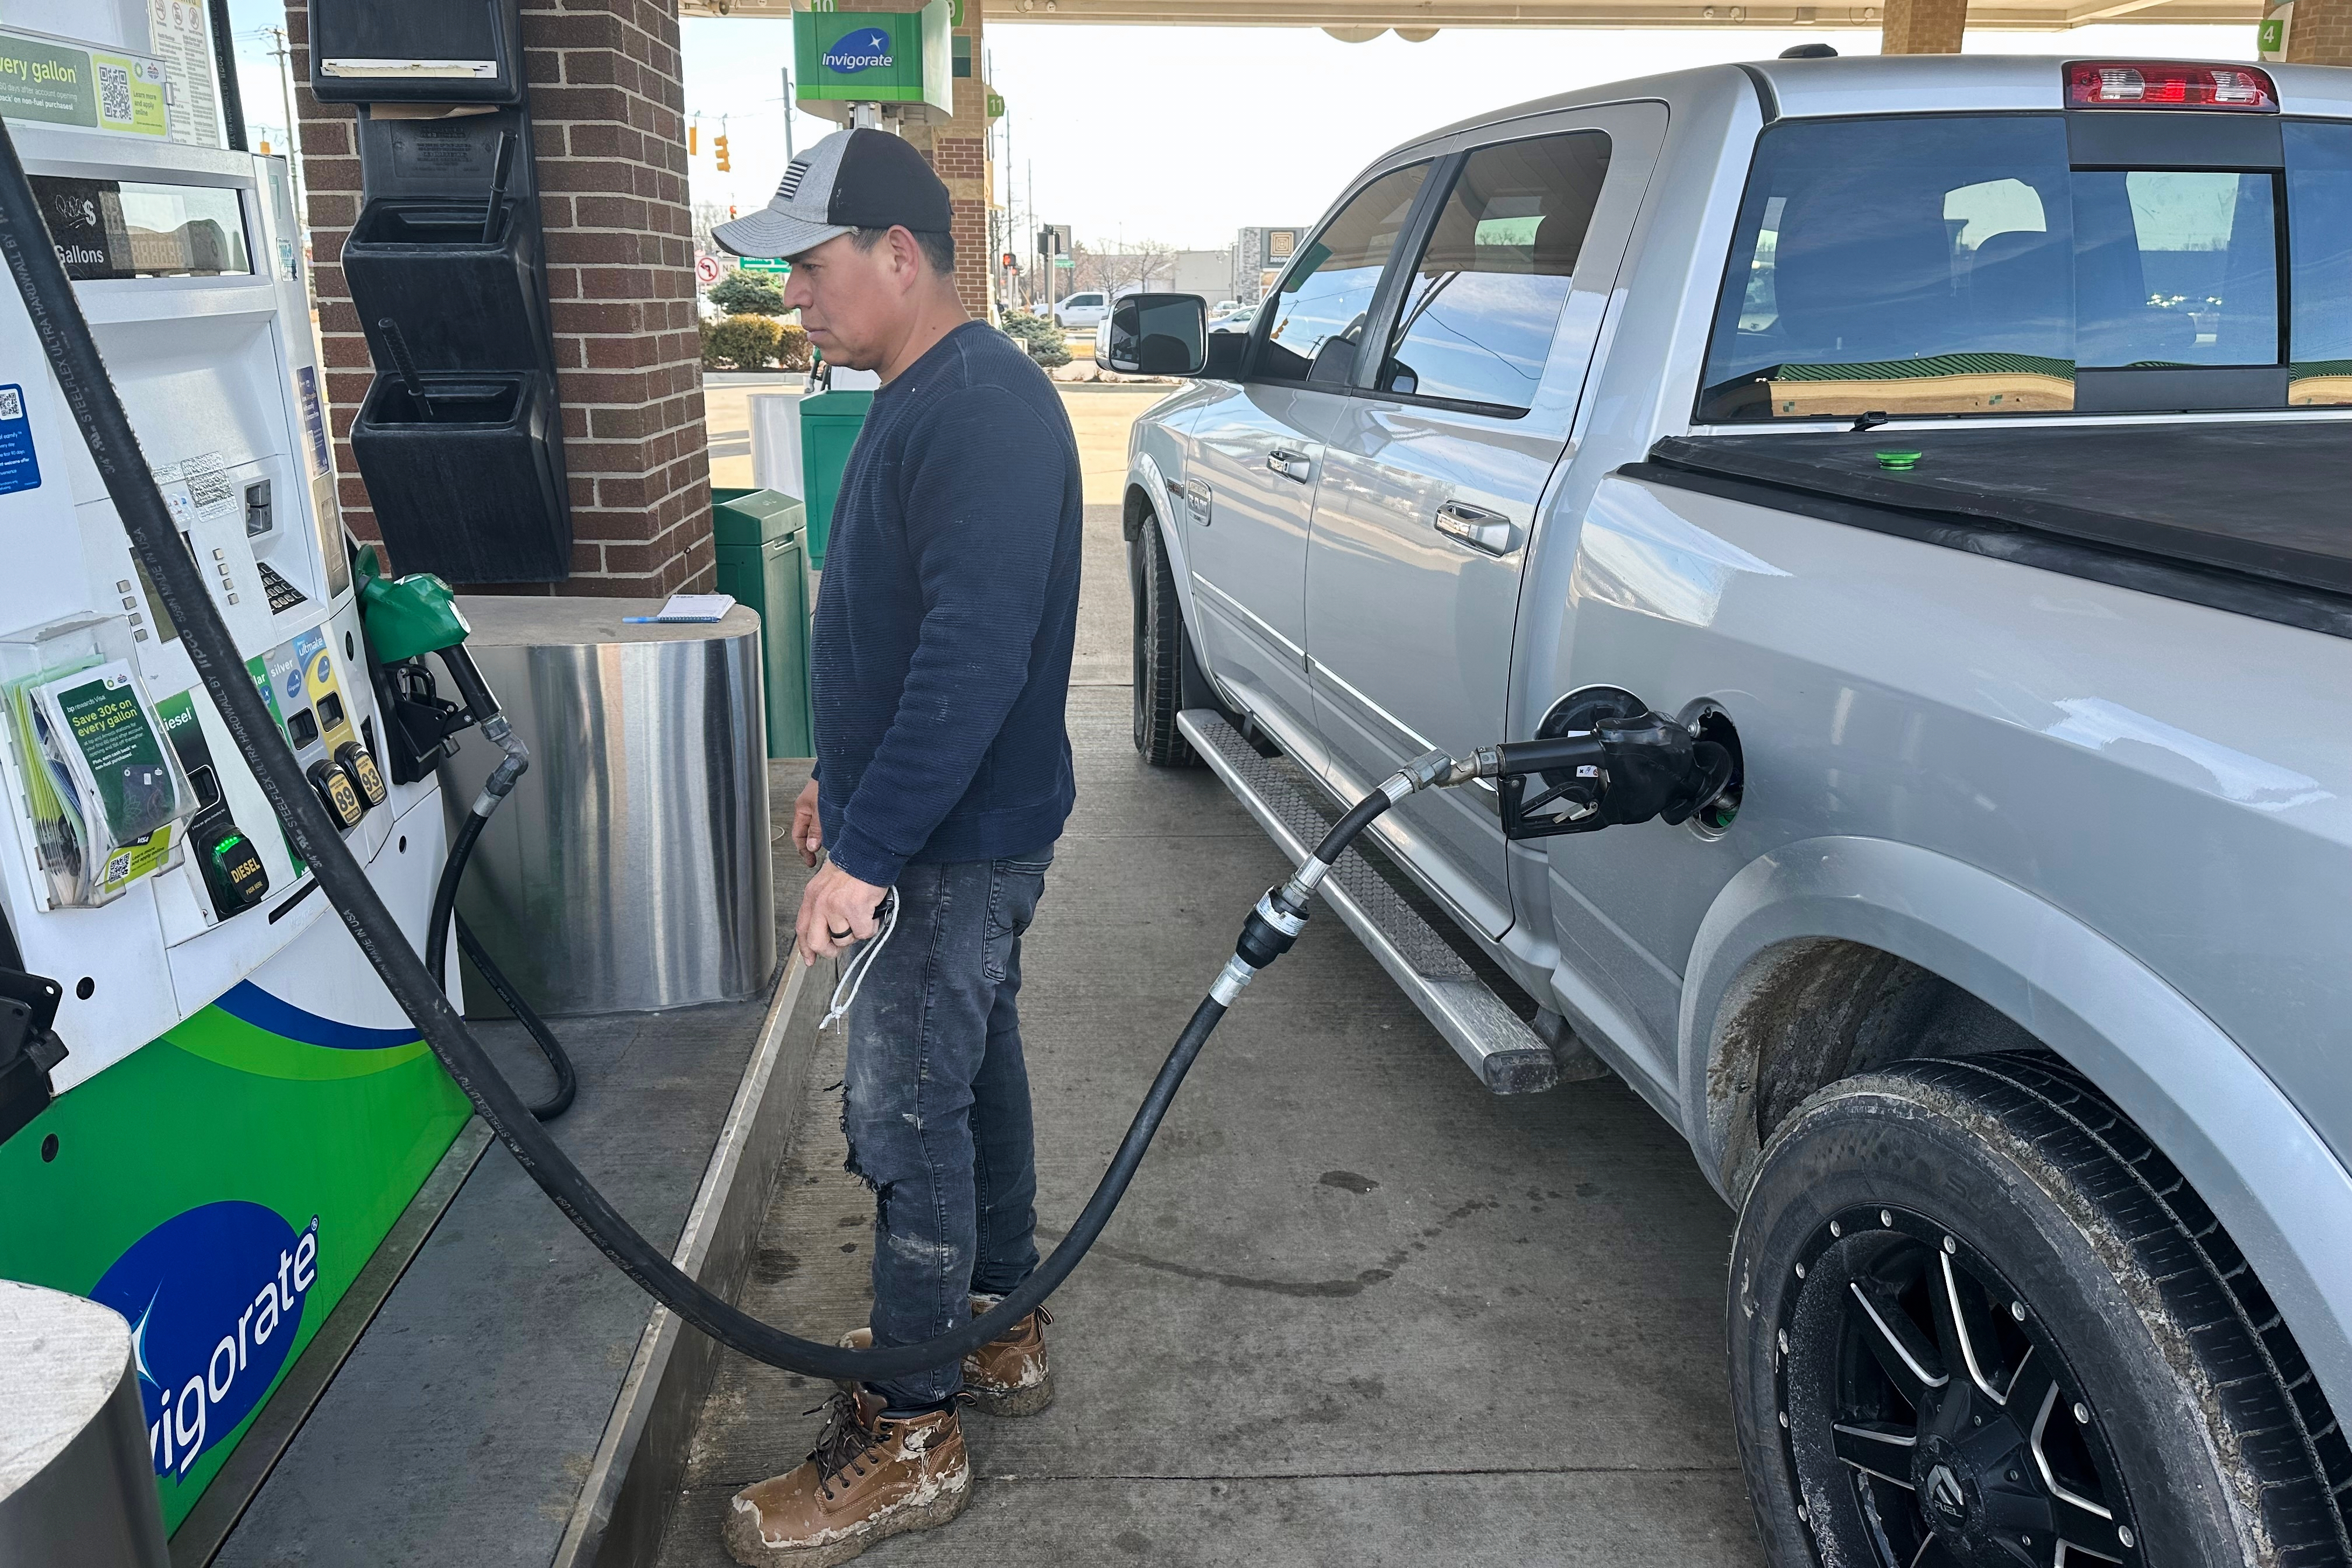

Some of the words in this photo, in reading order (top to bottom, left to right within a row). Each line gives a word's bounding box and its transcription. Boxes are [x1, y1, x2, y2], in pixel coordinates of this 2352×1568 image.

[2263, 26, 2274, 43] 4
[822, 53, 892, 69] Invigorate
[7, 84, 20, 94] days
[34, 88, 55, 97] account
[57, 92, 77, 102] opening
[133, 90, 145, 99] Learn
[142, 102, 154, 110] apply
[990, 99, 1003, 112] 11
[83, 200, 96, 227] $
[1, 232, 18, 248] BY
[55, 244, 104, 264] Gallons
[9, 253, 46, 315] HARDWALL
[38, 318, 63, 355] ULTRA
[57, 359, 93, 422] STEELFLEX
[1188, 494, 1207, 514] RAM
[132, 527, 150, 549] USA
[144, 551, 157, 564] IN
[150, 565, 173, 596] MADE
[298, 636, 324, 656] ultimate
[270, 659, 293, 677] silver
[206, 674, 220, 688] BY
[72, 712, 97, 727] Save
[97, 704, 118, 718] 30¢
[119, 699, 132, 709] on
[75, 699, 95, 710] rewards
[215, 690, 250, 743] HARDWALL
[78, 720, 106, 737] every
[244, 744, 267, 774] ULTRA
[362, 768, 380, 792] 93
[261, 776, 298, 827] STEELFLEX
[335, 786, 355, 812] 89
[230, 857, 261, 884] DIESEL
[342, 909, 360, 928] USA
[354, 928, 366, 937] IN
[1500, 1054, 1551, 1066] RAM
[555, 1195, 570, 1209] USA
[1934, 1500, 1963, 1517] FUEL
